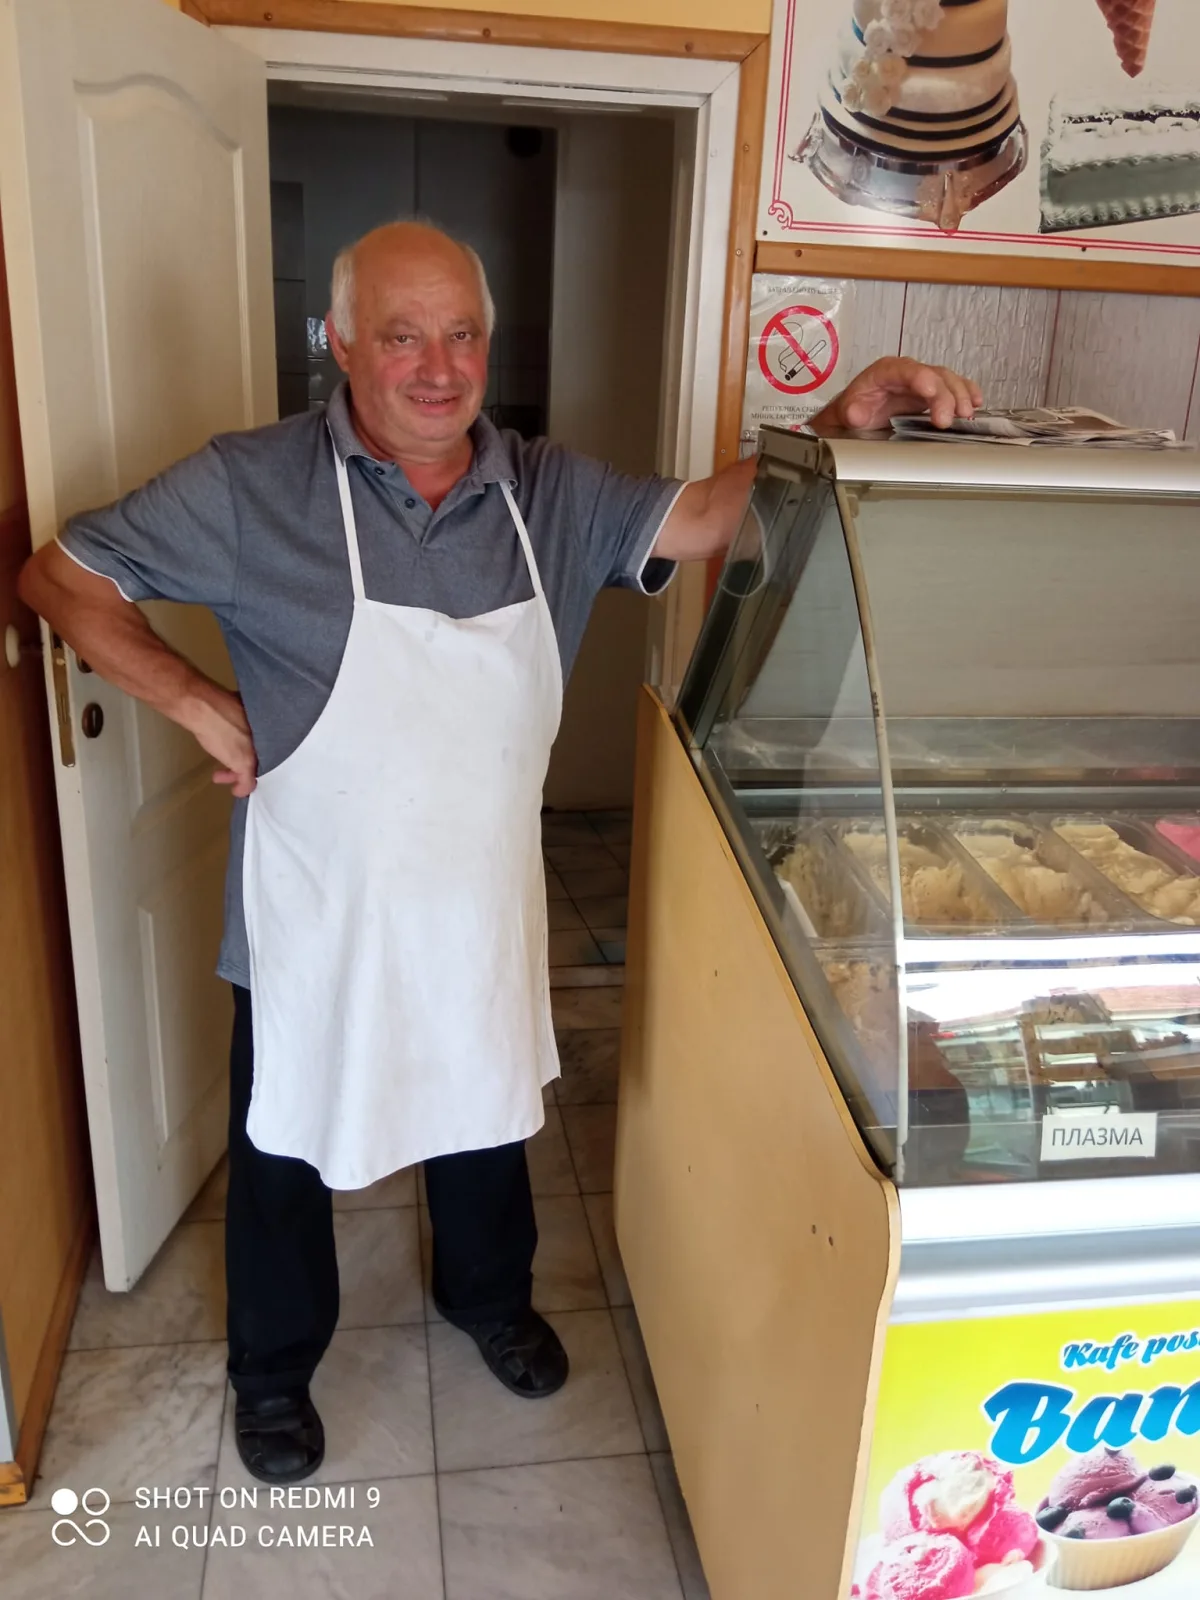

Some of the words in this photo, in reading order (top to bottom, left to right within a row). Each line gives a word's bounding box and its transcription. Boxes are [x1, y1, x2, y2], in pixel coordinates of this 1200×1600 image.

[1052, 1127, 1143, 1146] ПЛАЗМА
[1063, 1334, 1139, 1370] Kafe
[1141, 1331, 1200, 1364] pos
